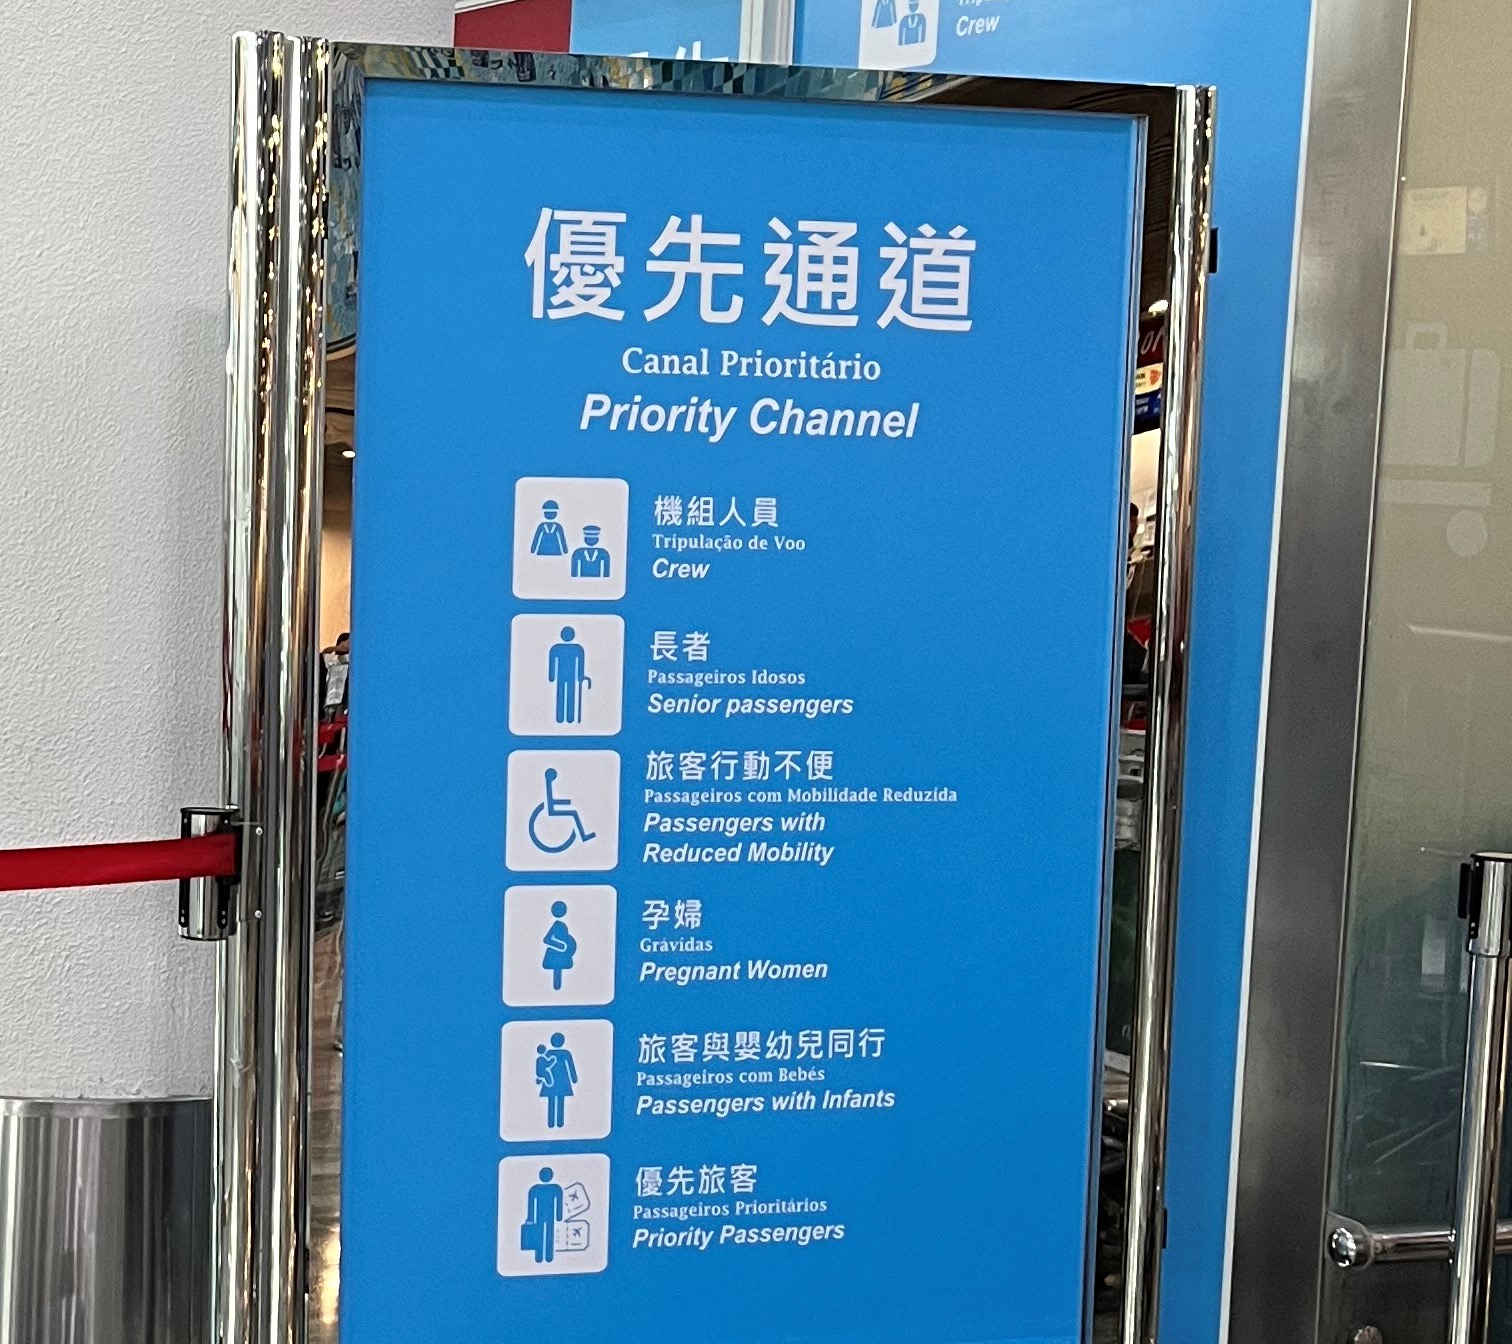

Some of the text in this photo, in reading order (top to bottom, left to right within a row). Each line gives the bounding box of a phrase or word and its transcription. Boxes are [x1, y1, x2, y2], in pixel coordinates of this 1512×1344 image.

[956, 15, 1001, 37] Crew
[524, 207, 977, 332] 優先通道
[622, 346, 881, 381] Canal Prioritário
[579, 393, 920, 443] Priority Channel
[654, 494, 779, 528] 機組人員
[651, 533, 806, 553] Tripulação de Voo
[652, 557, 711, 579] Crew
[649, 630, 711, 662] 長者
[647, 668, 806, 688] Passageiros Idosos
[647, 692, 854, 719] Senior passengers
[645, 749, 834, 781] 旅客行動不便
[644, 787, 958, 807] Passageiros com Mobilidade Reduzida
[643, 811, 826, 838] Passengers with
[642, 841, 835, 867] Reduced Mobility
[642, 899, 702, 930] 孕婦
[639, 936, 713, 953] Grávidas
[639, 959, 828, 986] Pregnant Women
[638, 1027, 886, 1064] 旅客與嬰幼兒同行
[636, 1066, 825, 1089] Passageiros com Bebés
[636, 1088, 896, 1118] Passengers with Infants
[635, 1163, 758, 1197] 優先旅客
[633, 1198, 828, 1221] Passageiros Prioritários
[632, 1224, 845, 1251] Priority Passengers
